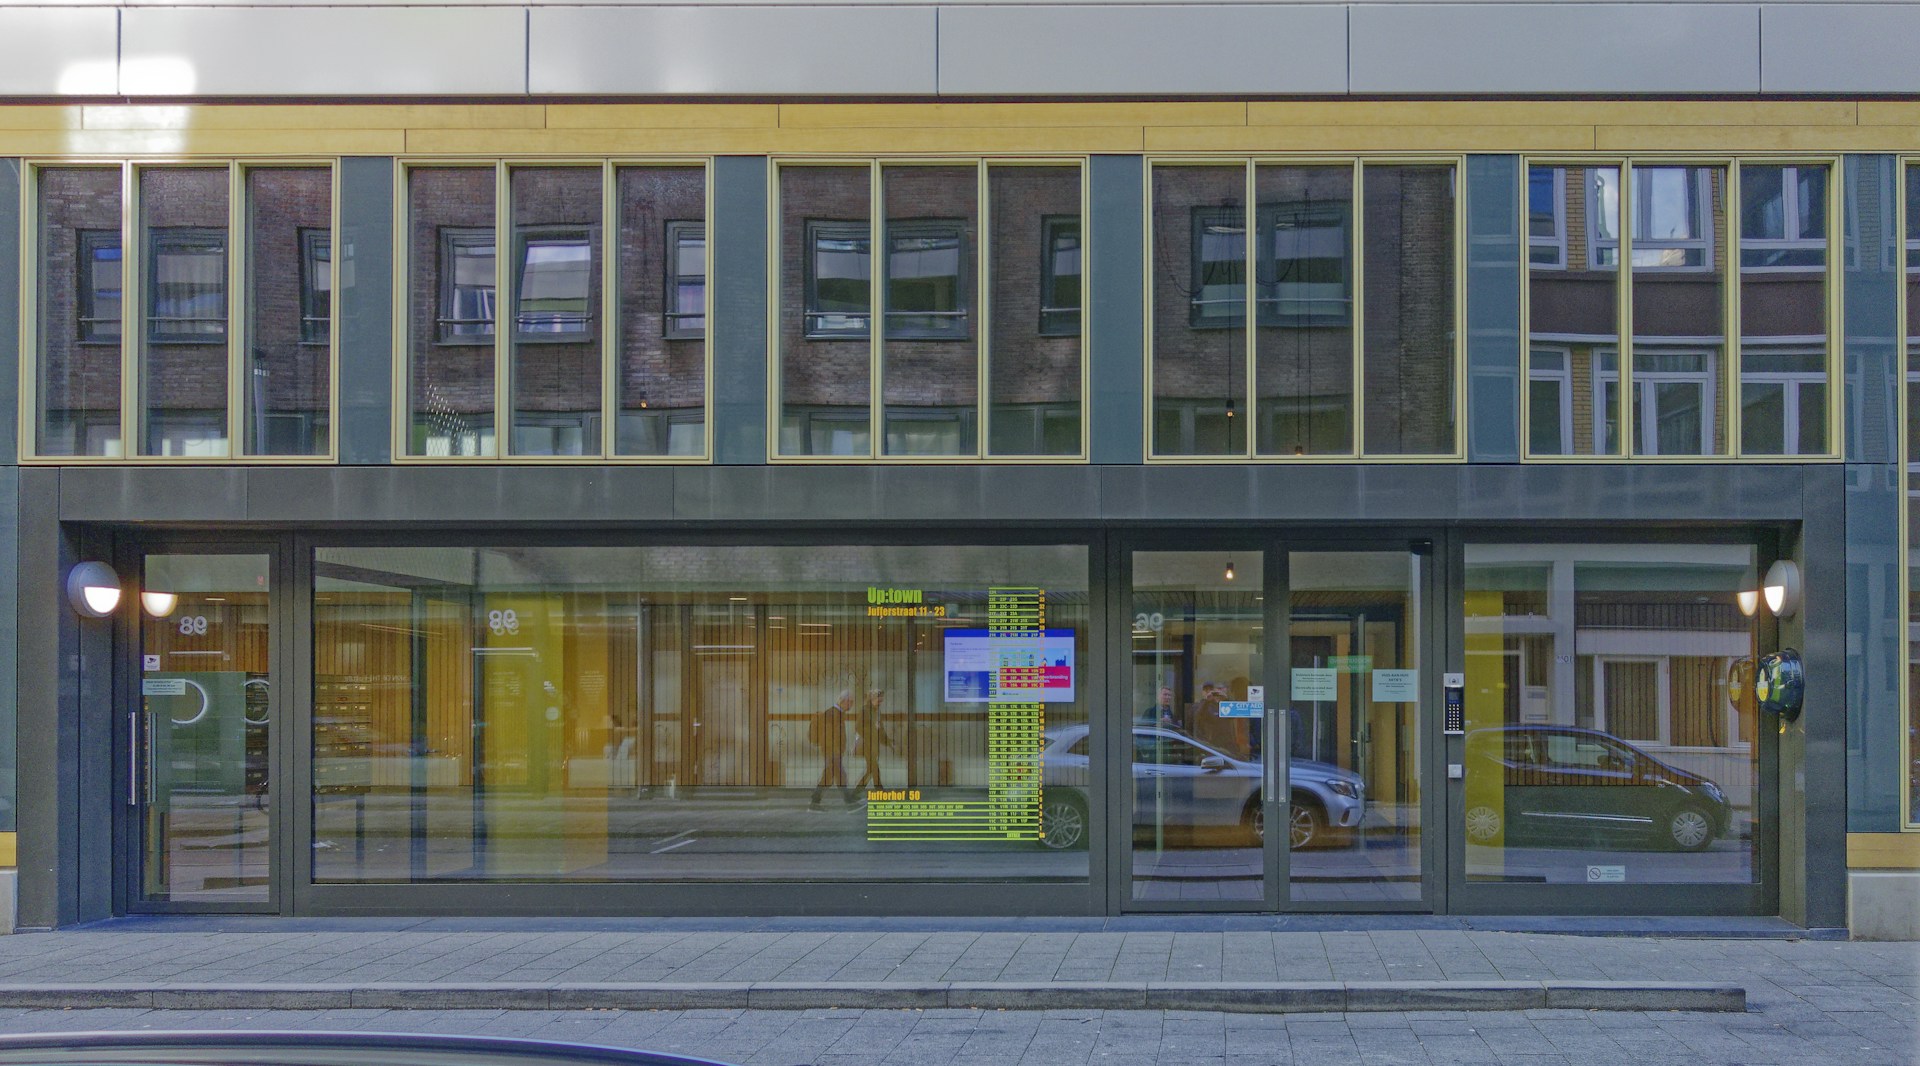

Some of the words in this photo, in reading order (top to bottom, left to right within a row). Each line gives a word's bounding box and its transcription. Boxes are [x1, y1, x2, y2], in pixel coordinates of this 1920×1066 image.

[867, 587, 922, 605] Up:town
[867, 606, 917, 616] Jufferstraat
[919, 606, 927, 616] 11
[934, 606, 945, 616] 23
[867, 790, 906, 801] Jufferhof
[909, 790, 920, 801] 50
